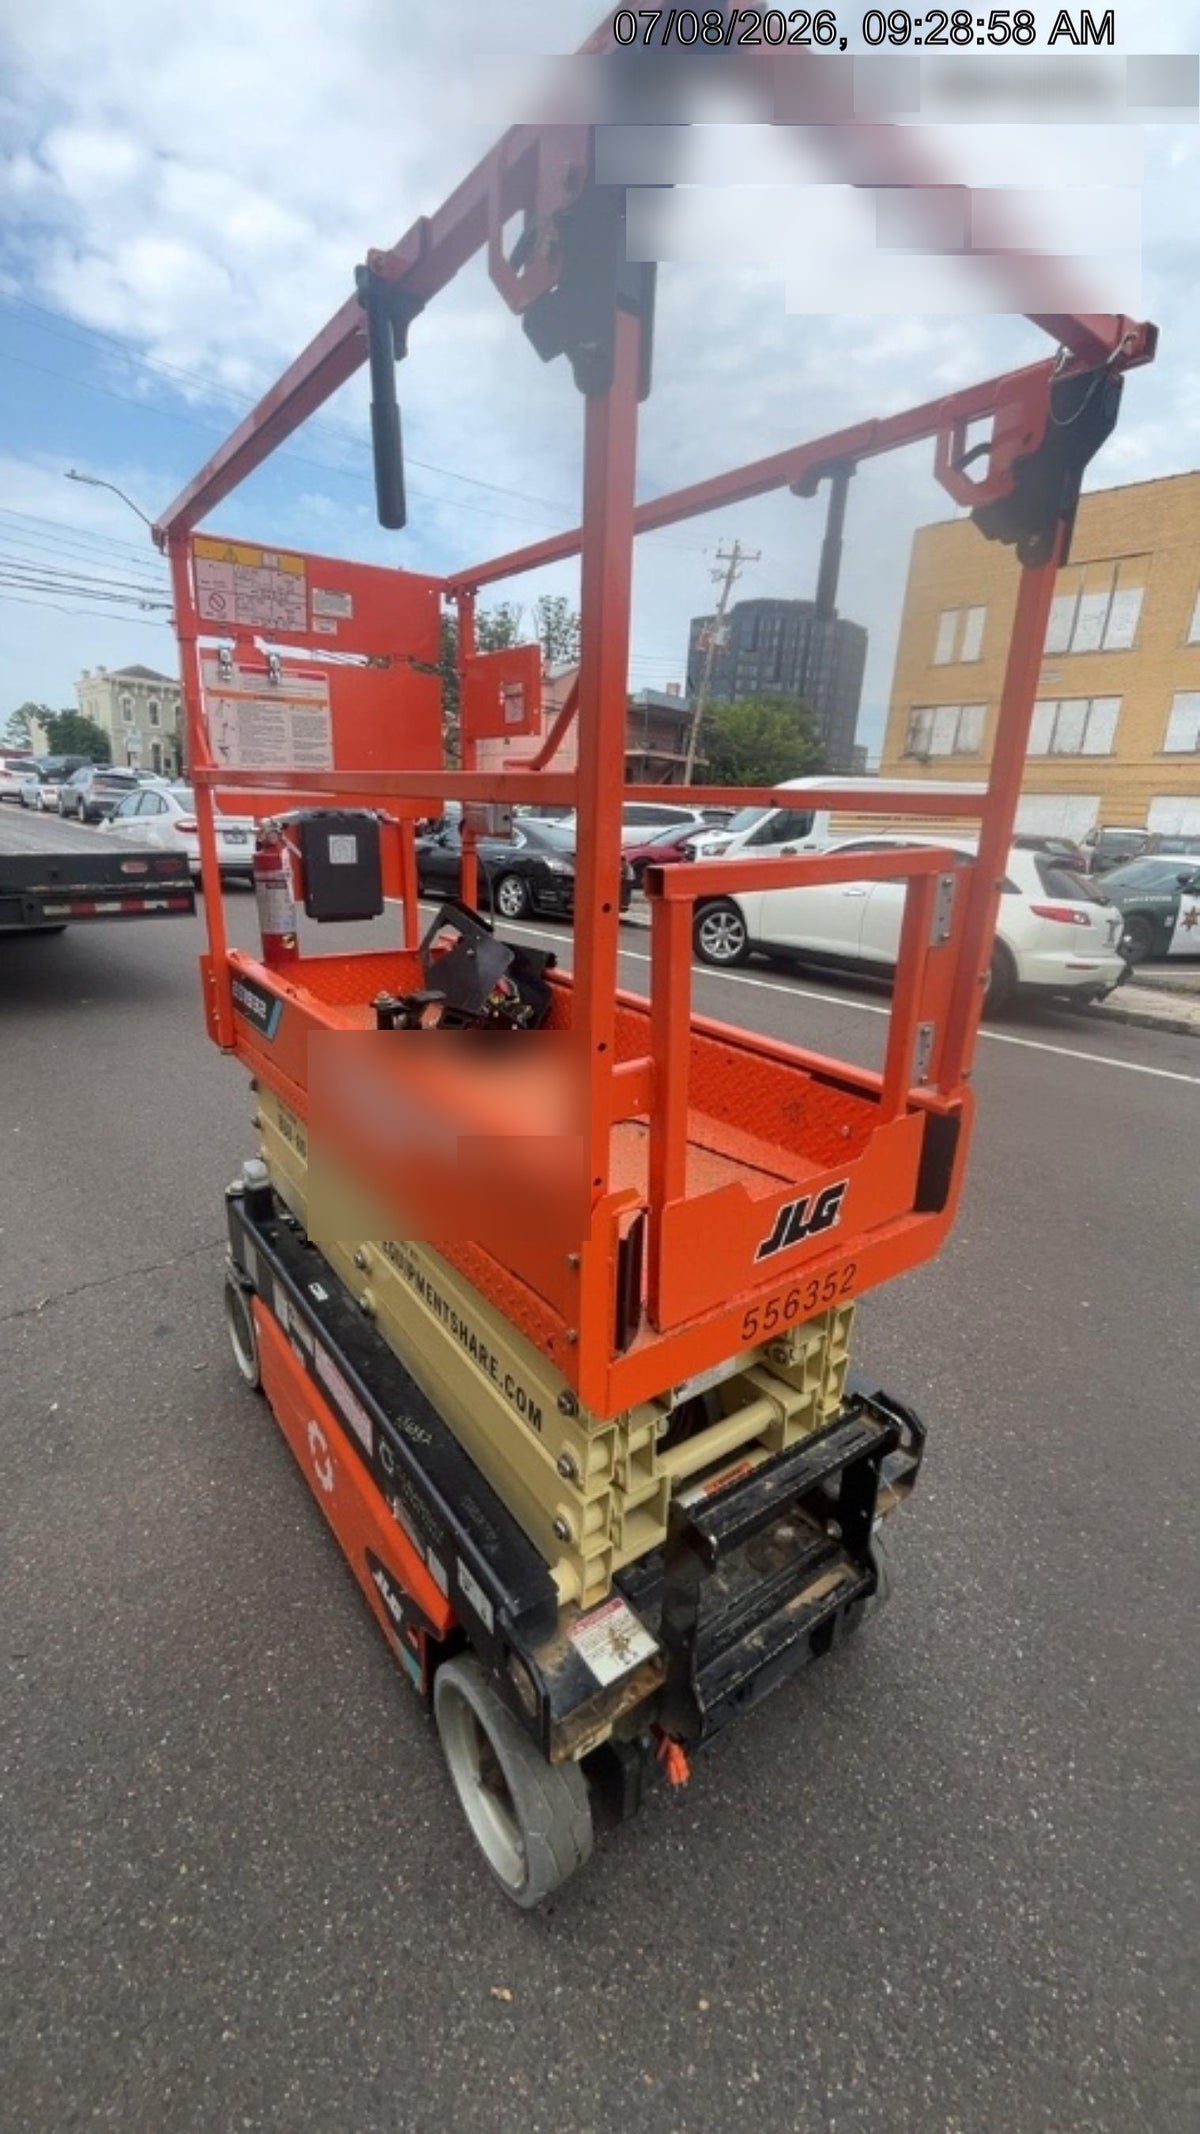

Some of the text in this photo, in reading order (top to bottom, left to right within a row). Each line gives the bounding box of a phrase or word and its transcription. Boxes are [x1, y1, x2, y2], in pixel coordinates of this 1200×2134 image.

[754, 1180, 848, 1263] JLG
[381, 1240, 543, 1432] EQUIPMENTSHARE.COM
[742, 1264, 857, 1340] 556352
